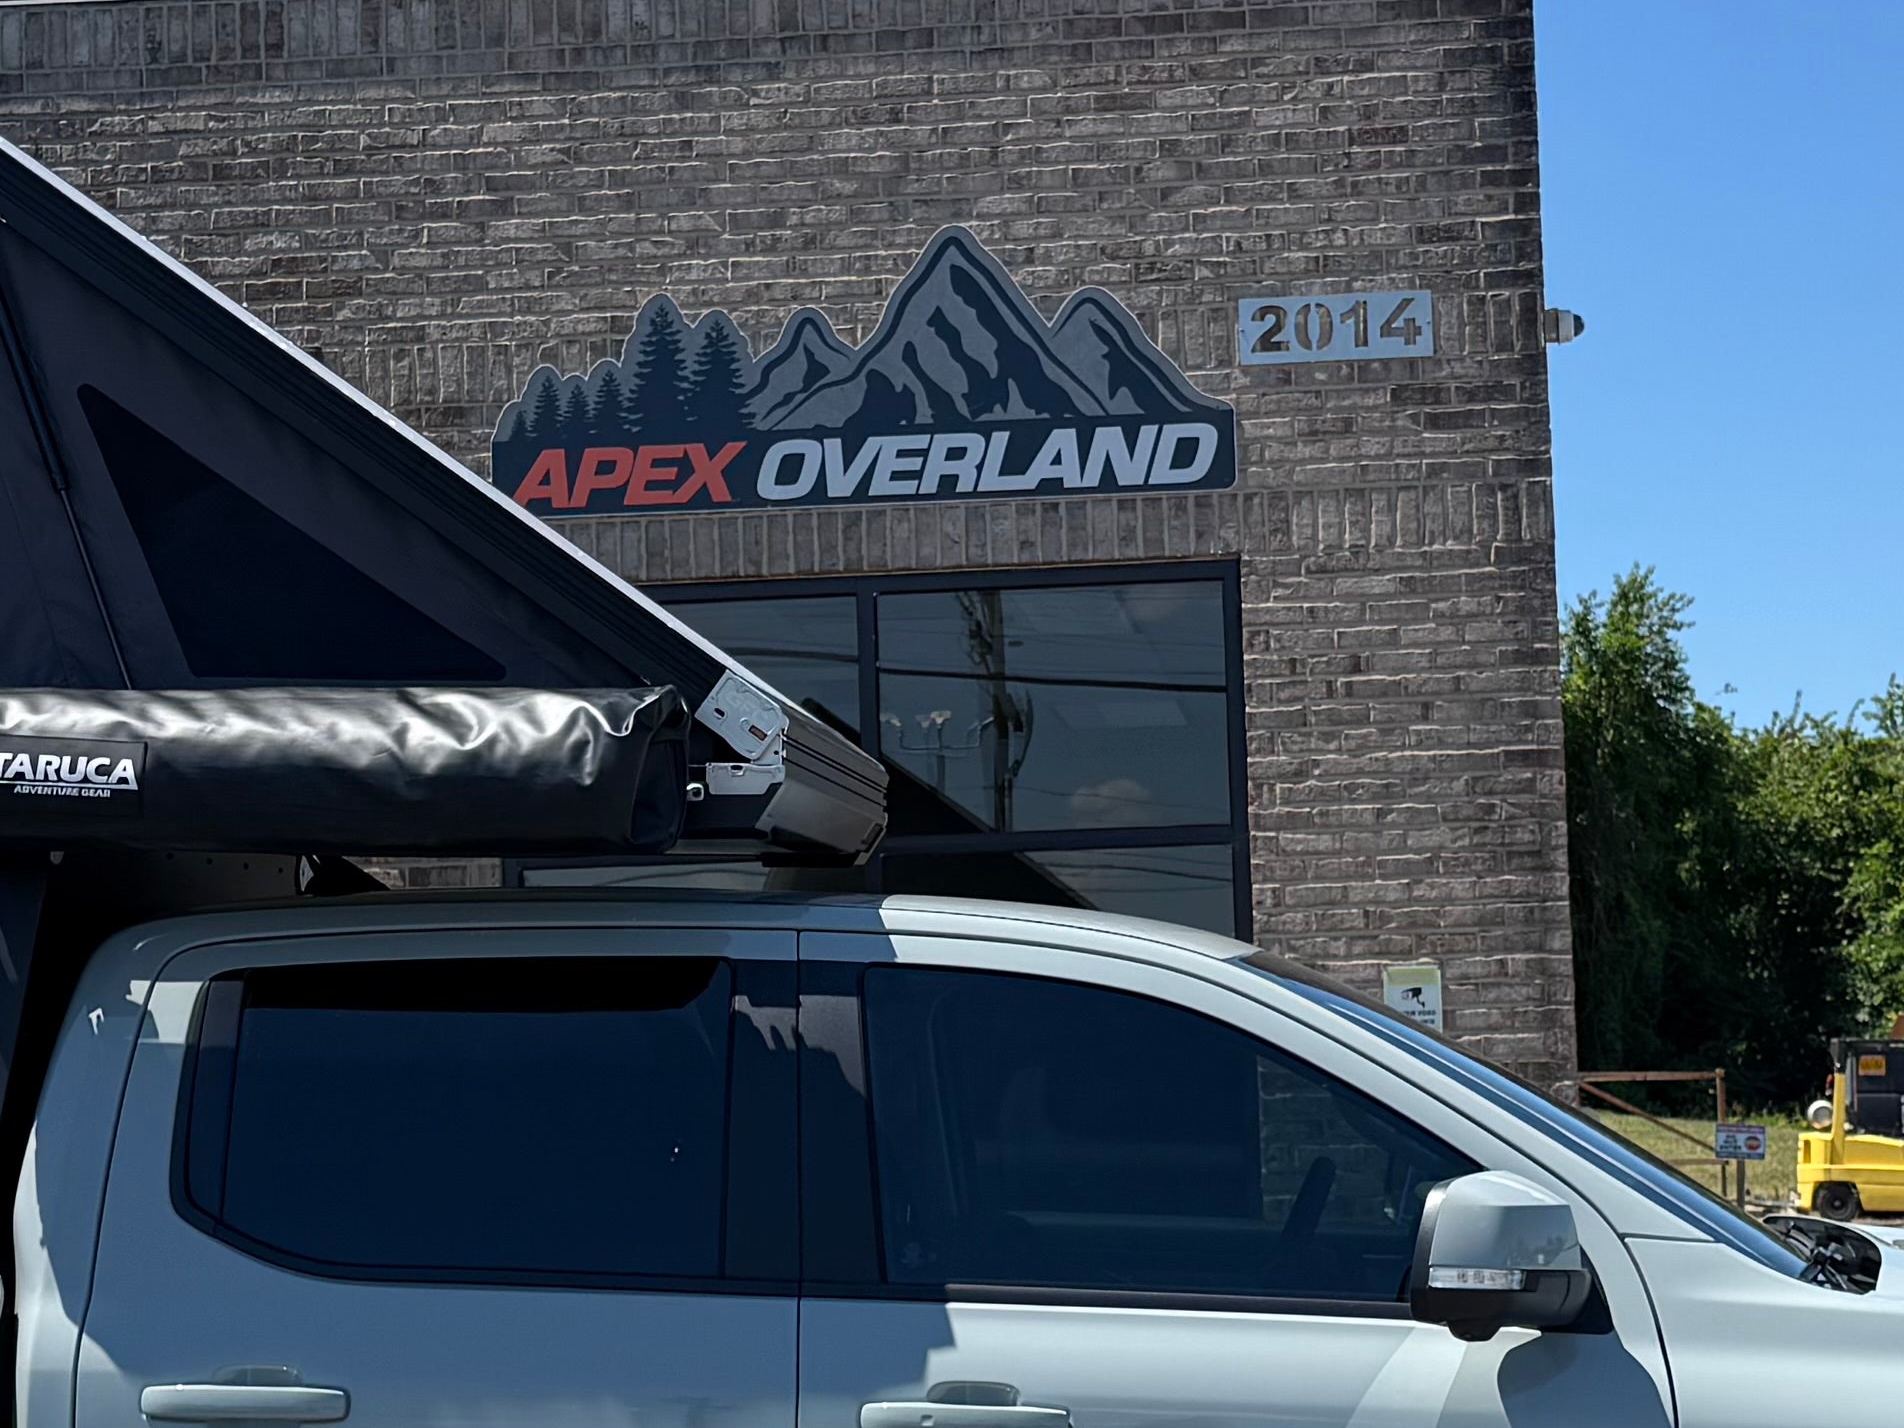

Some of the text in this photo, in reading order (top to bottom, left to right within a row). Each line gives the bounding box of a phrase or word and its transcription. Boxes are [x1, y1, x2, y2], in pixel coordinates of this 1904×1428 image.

[1251, 297, 1422, 353] 2014
[512, 422, 1218, 509] APEX OVERLAND
[13, 784, 111, 798] ADVENTURE GEAR
